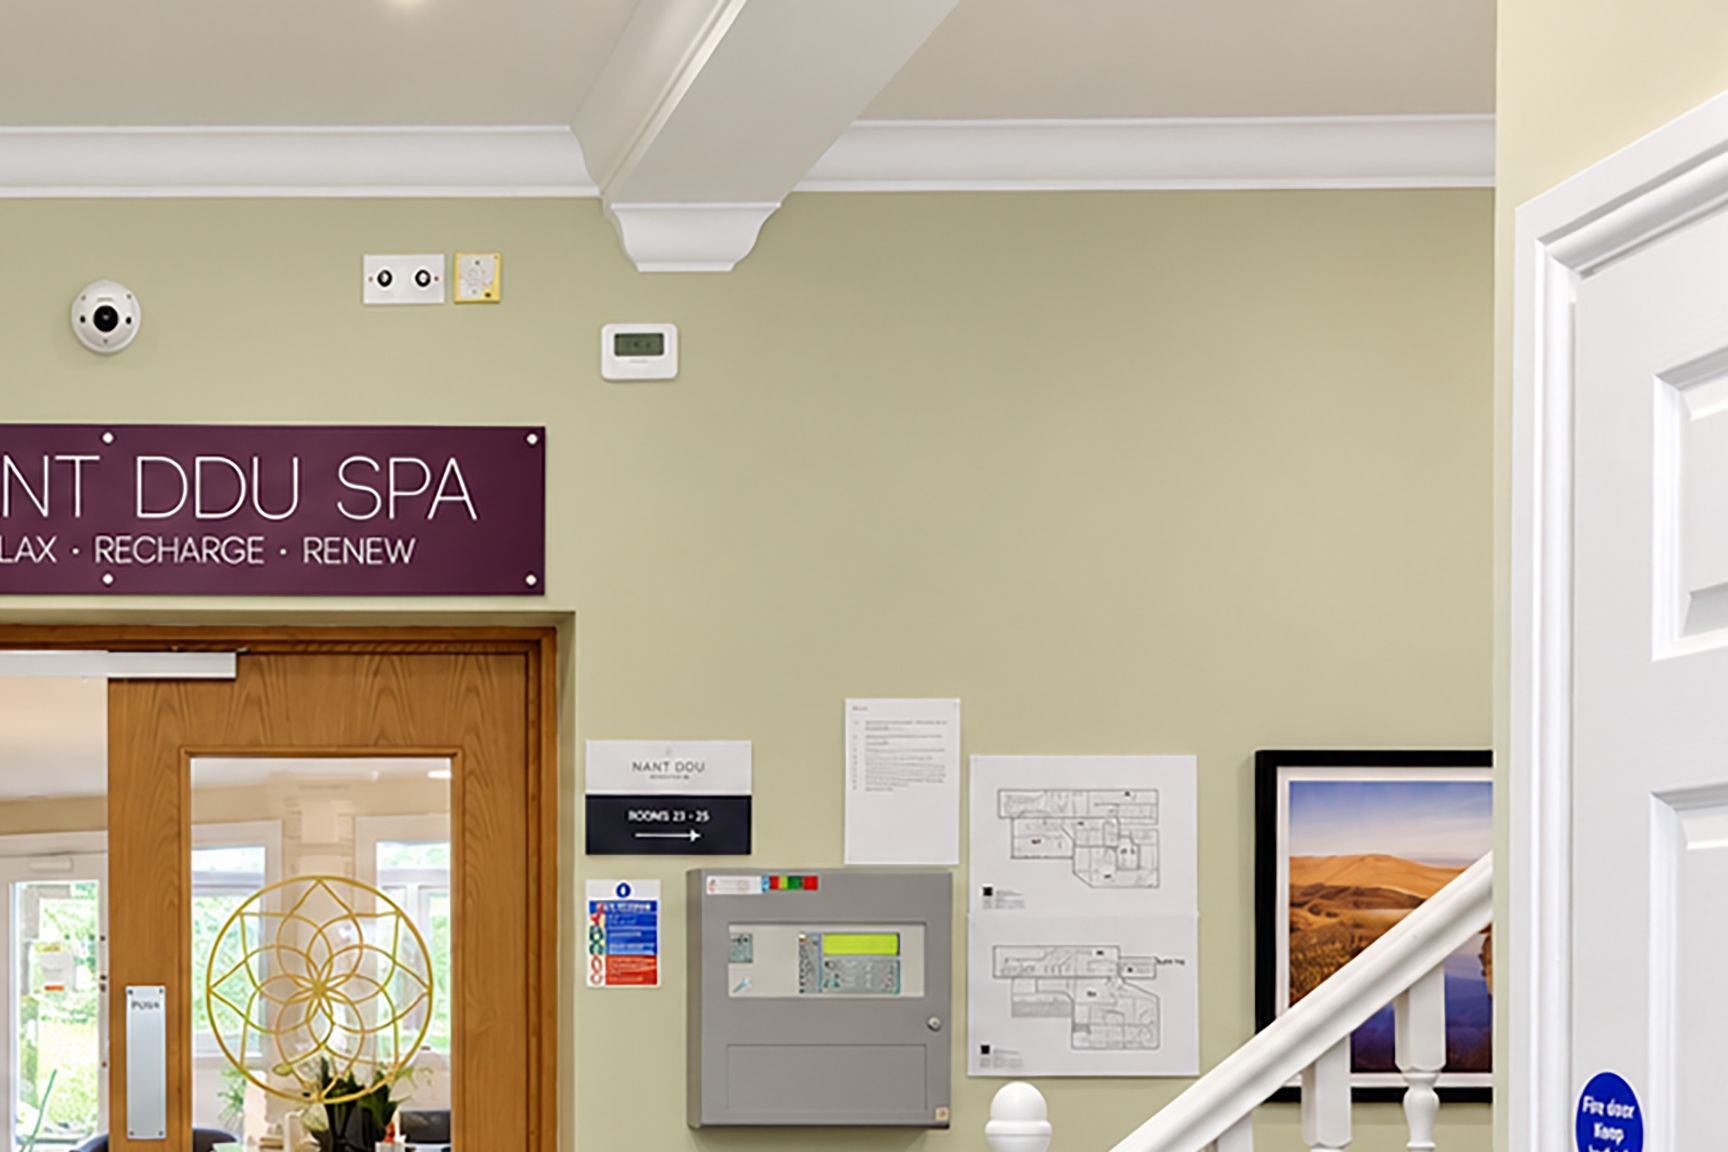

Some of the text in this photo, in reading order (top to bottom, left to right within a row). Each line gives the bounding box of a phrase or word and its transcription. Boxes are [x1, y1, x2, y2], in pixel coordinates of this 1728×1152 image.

[136, 455, 300, 521] DDU
[336, 456, 479, 521] SPA
[94, 535, 265, 565] RECHARGE
[303, 536, 417, 565] RENEW
[632, 761, 669, 772] NANT
[628, 810, 670, 822] ROOMS
